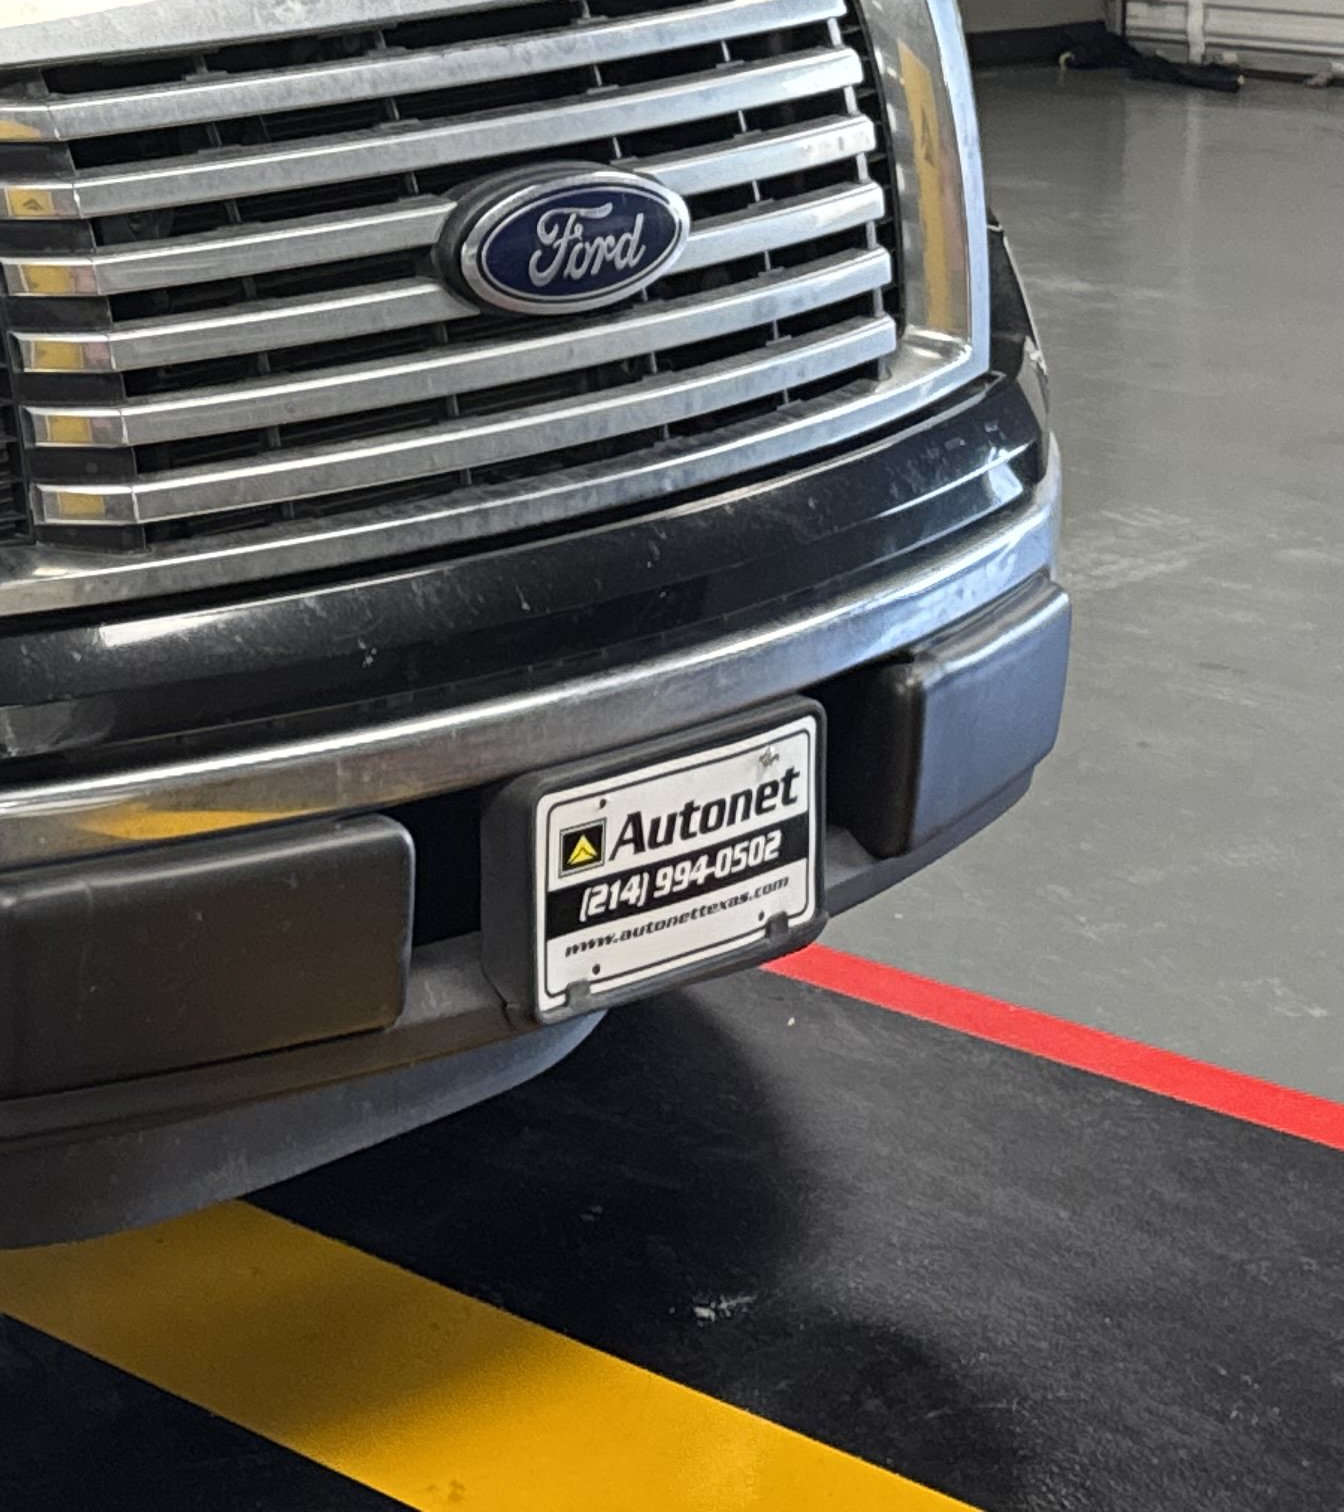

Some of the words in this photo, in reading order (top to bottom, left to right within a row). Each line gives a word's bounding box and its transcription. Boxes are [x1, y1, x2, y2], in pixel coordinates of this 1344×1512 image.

[529, 202, 645, 286] Ford
[609, 767, 800, 861] Autonet
[565, 877, 789, 957] www.autonettexas.com
[579, 872, 649, 922] (214)
[654, 830, 781, 896] 994-0502
